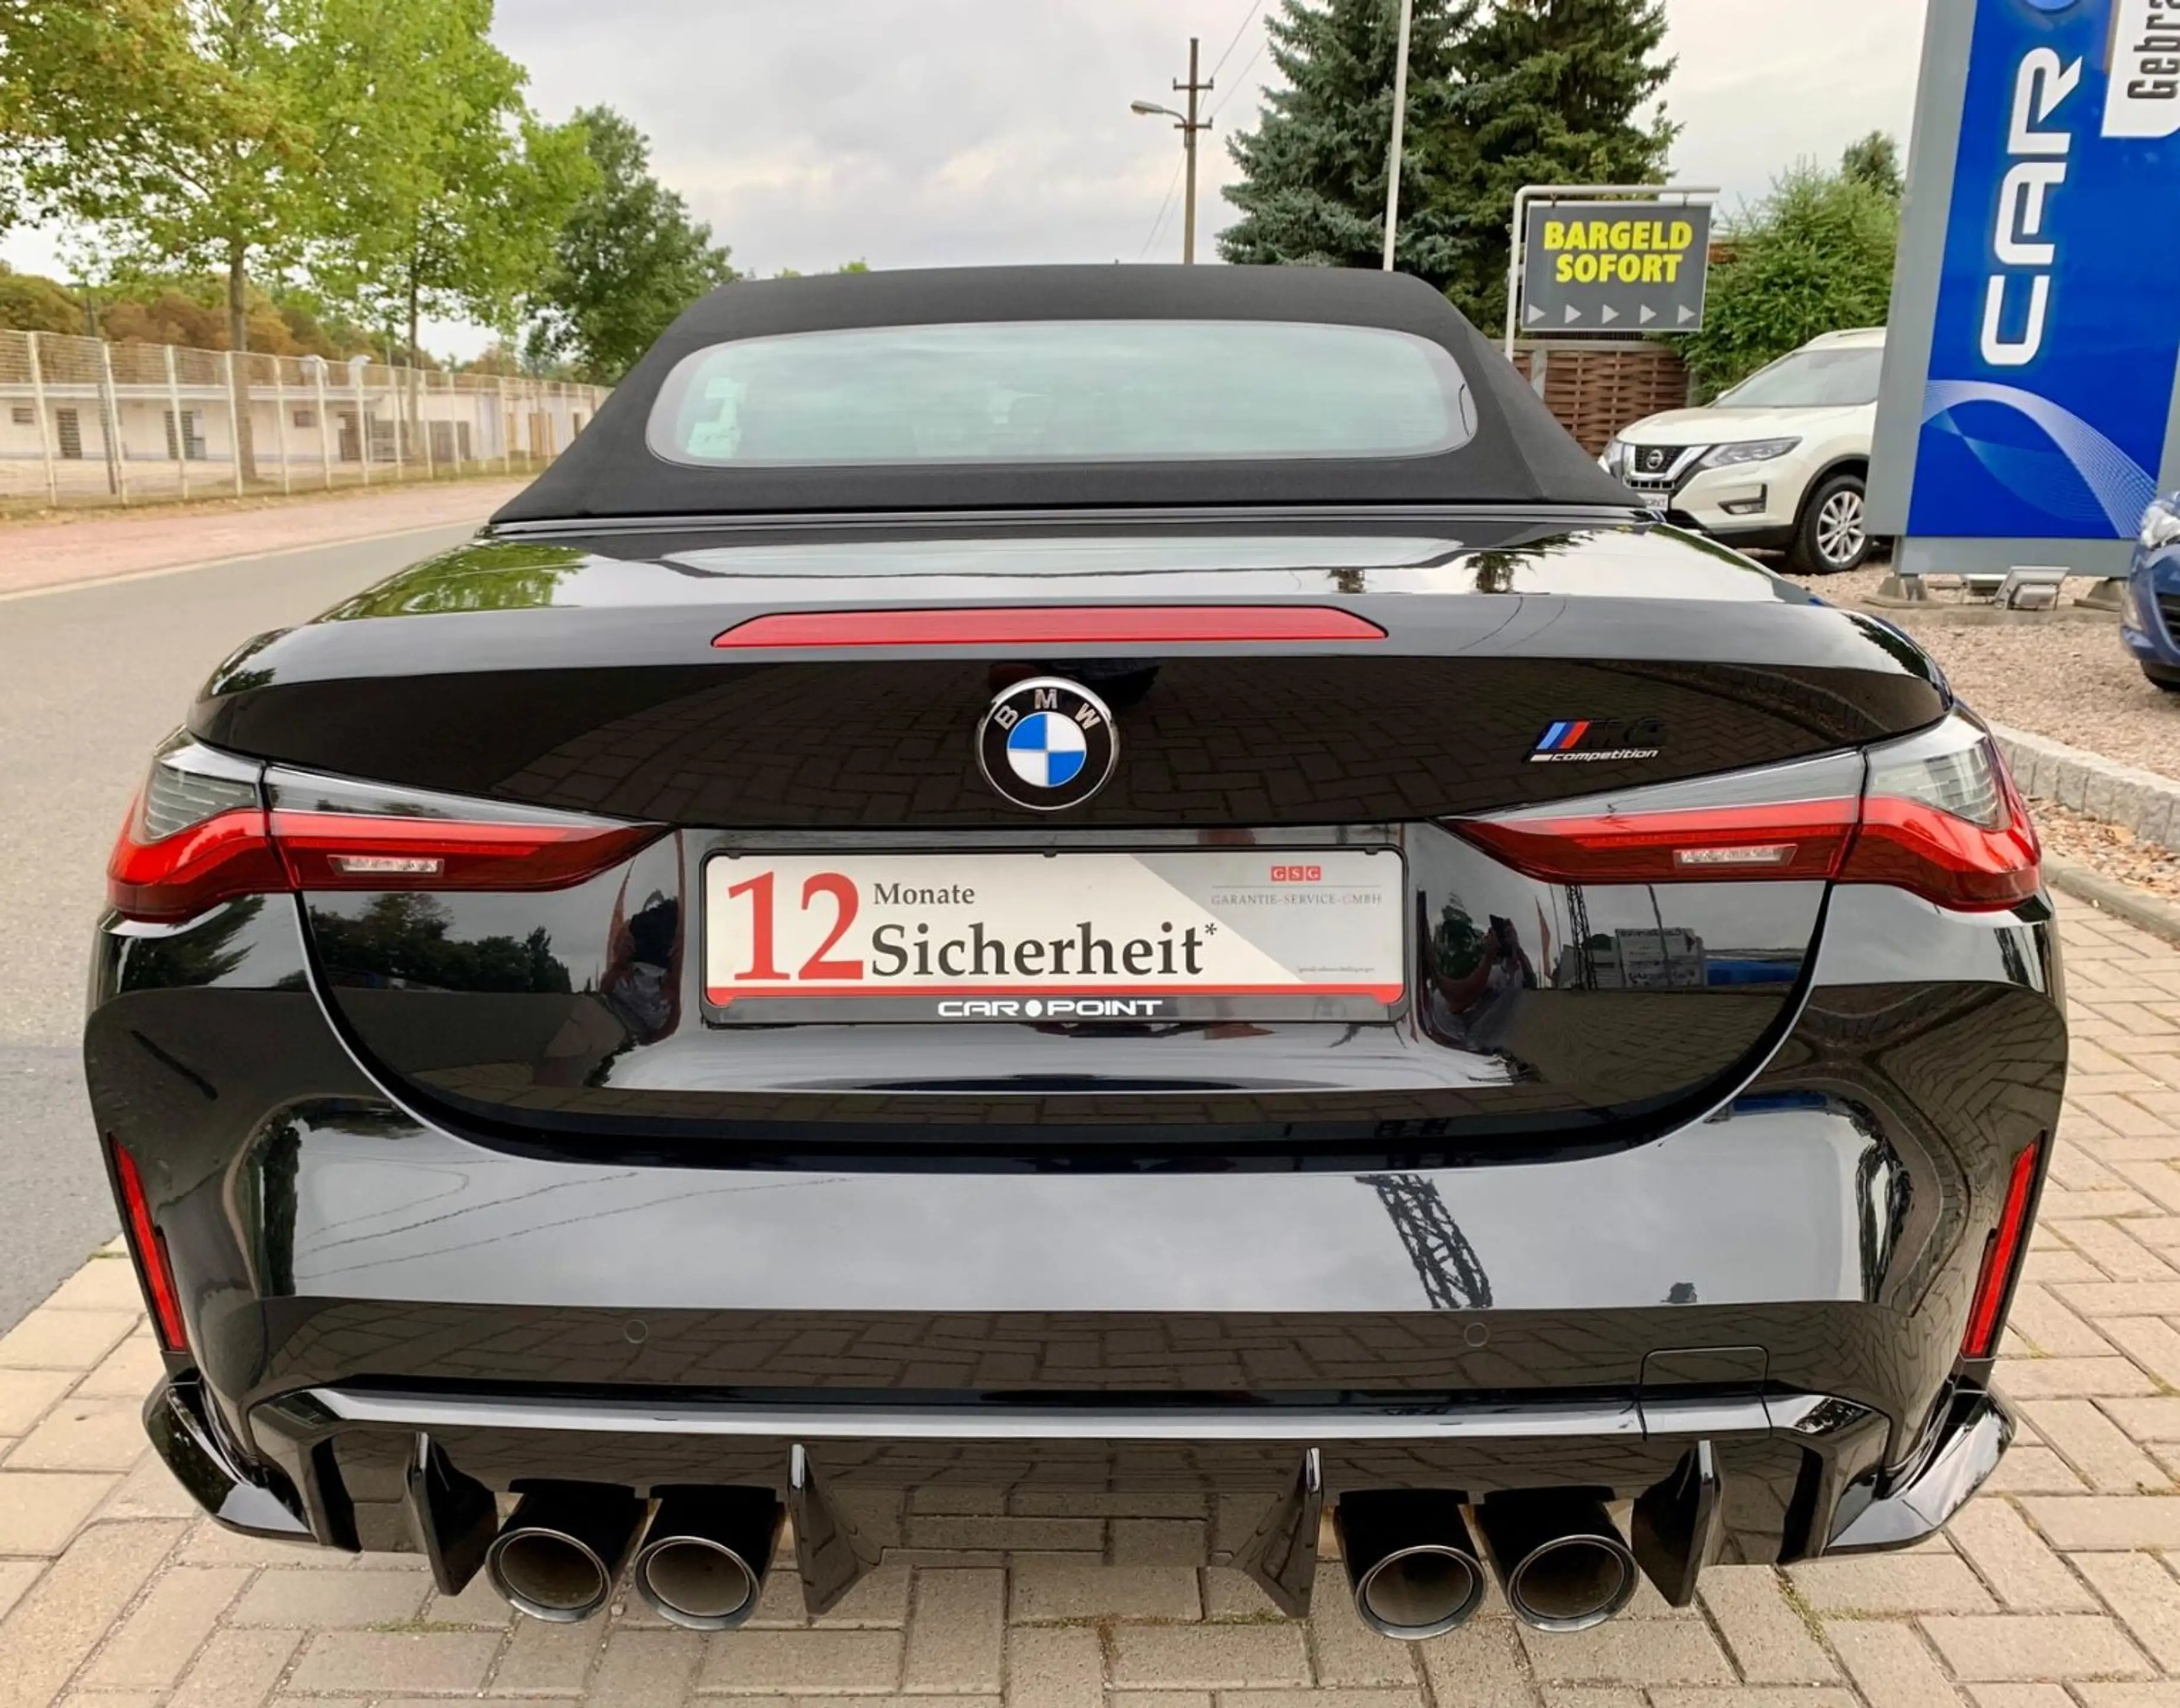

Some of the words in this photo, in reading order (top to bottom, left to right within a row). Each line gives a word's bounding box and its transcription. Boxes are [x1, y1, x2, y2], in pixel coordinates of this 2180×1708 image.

[1981, 47, 2082, 365] CAR
[1544, 221, 1693, 250] BARGELD
[1556, 253, 1683, 283] SOFORT
[994, 689, 1101, 730] BMW
[1551, 749, 1659, 761] competition
[1272, 866, 1321, 881] GSG
[874, 883, 975, 905] Monate
[728, 871, 863, 980] 12
[938, 1001, 1018, 1017] CAR
[1048, 1000, 1163, 1017] POINT
